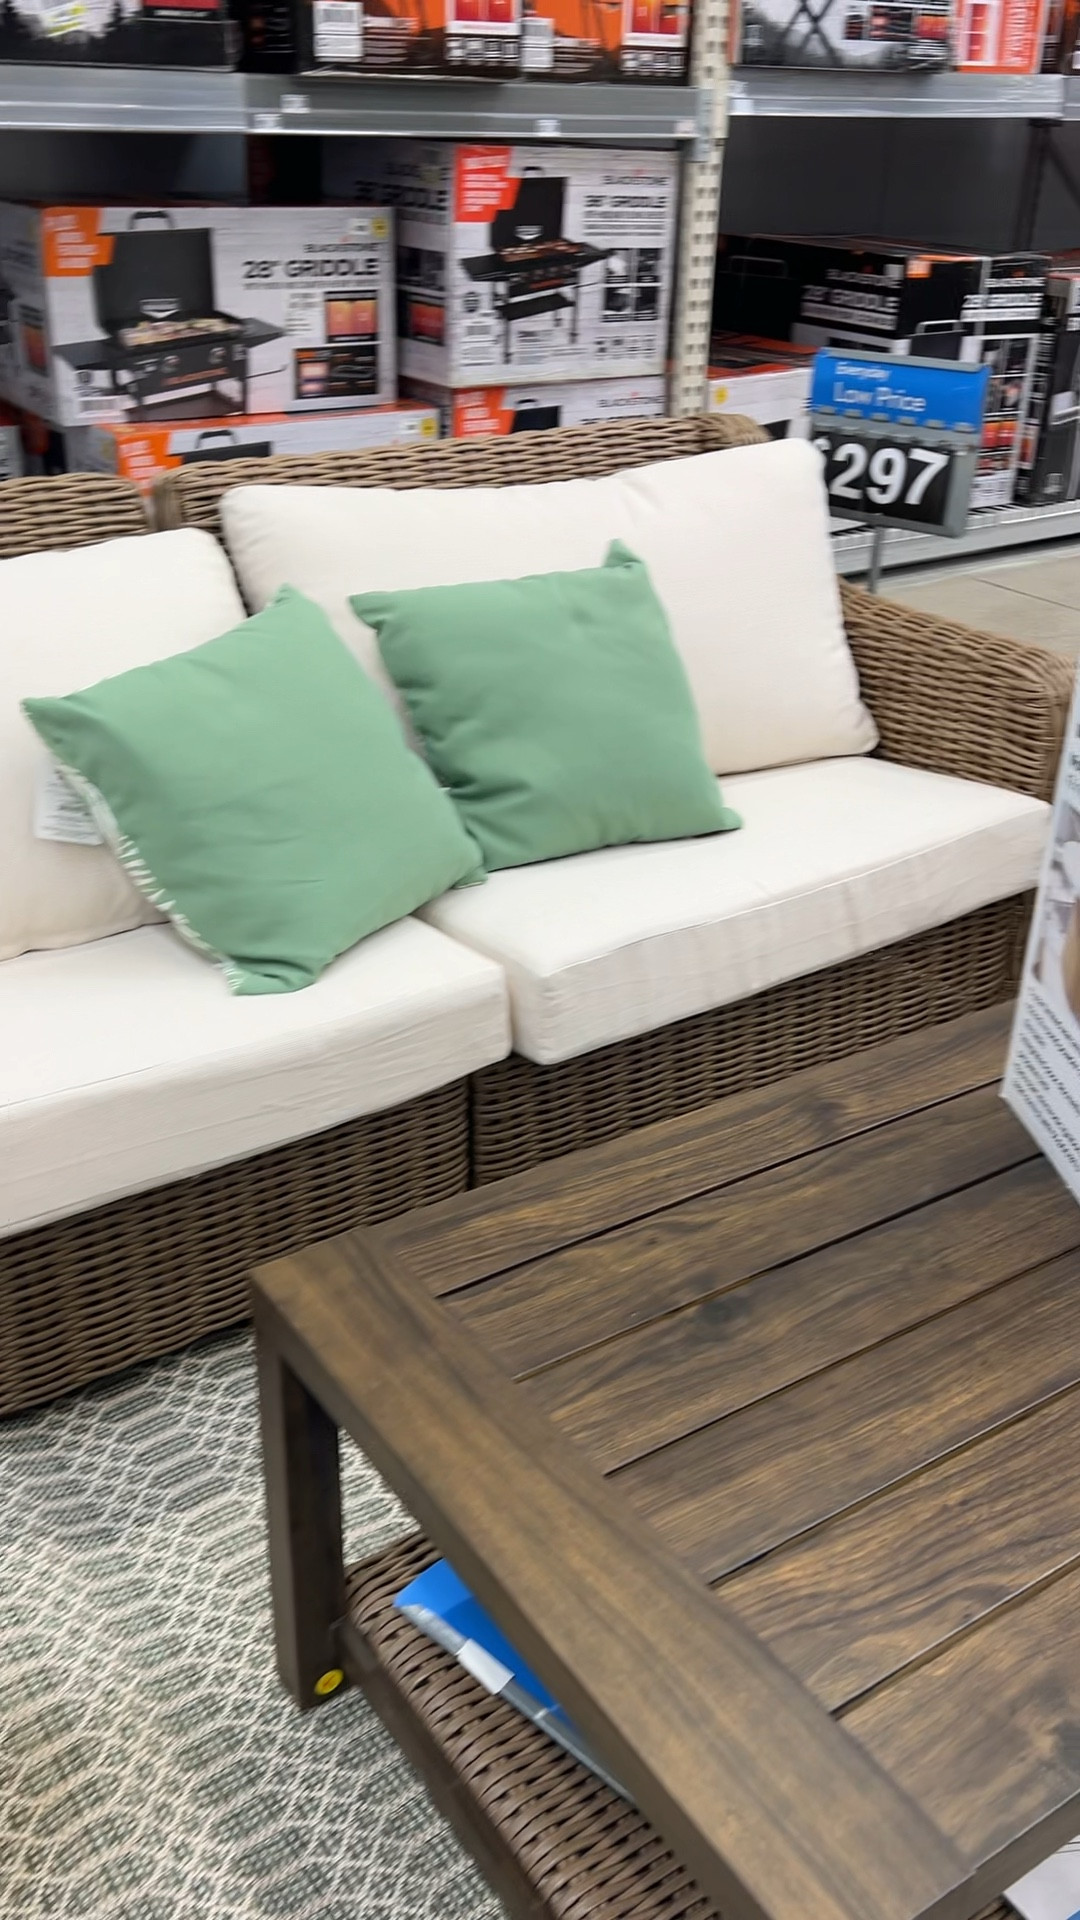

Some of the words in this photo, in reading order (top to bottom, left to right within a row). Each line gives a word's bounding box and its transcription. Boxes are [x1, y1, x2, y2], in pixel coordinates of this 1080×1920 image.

[610, 195, 667, 208] GRIDDLE
[284, 258, 380, 278] GRIDDLE
[833, 381, 873, 405] Low
[875, 386, 927, 412] Price
[813, 436, 950, 506] 297
